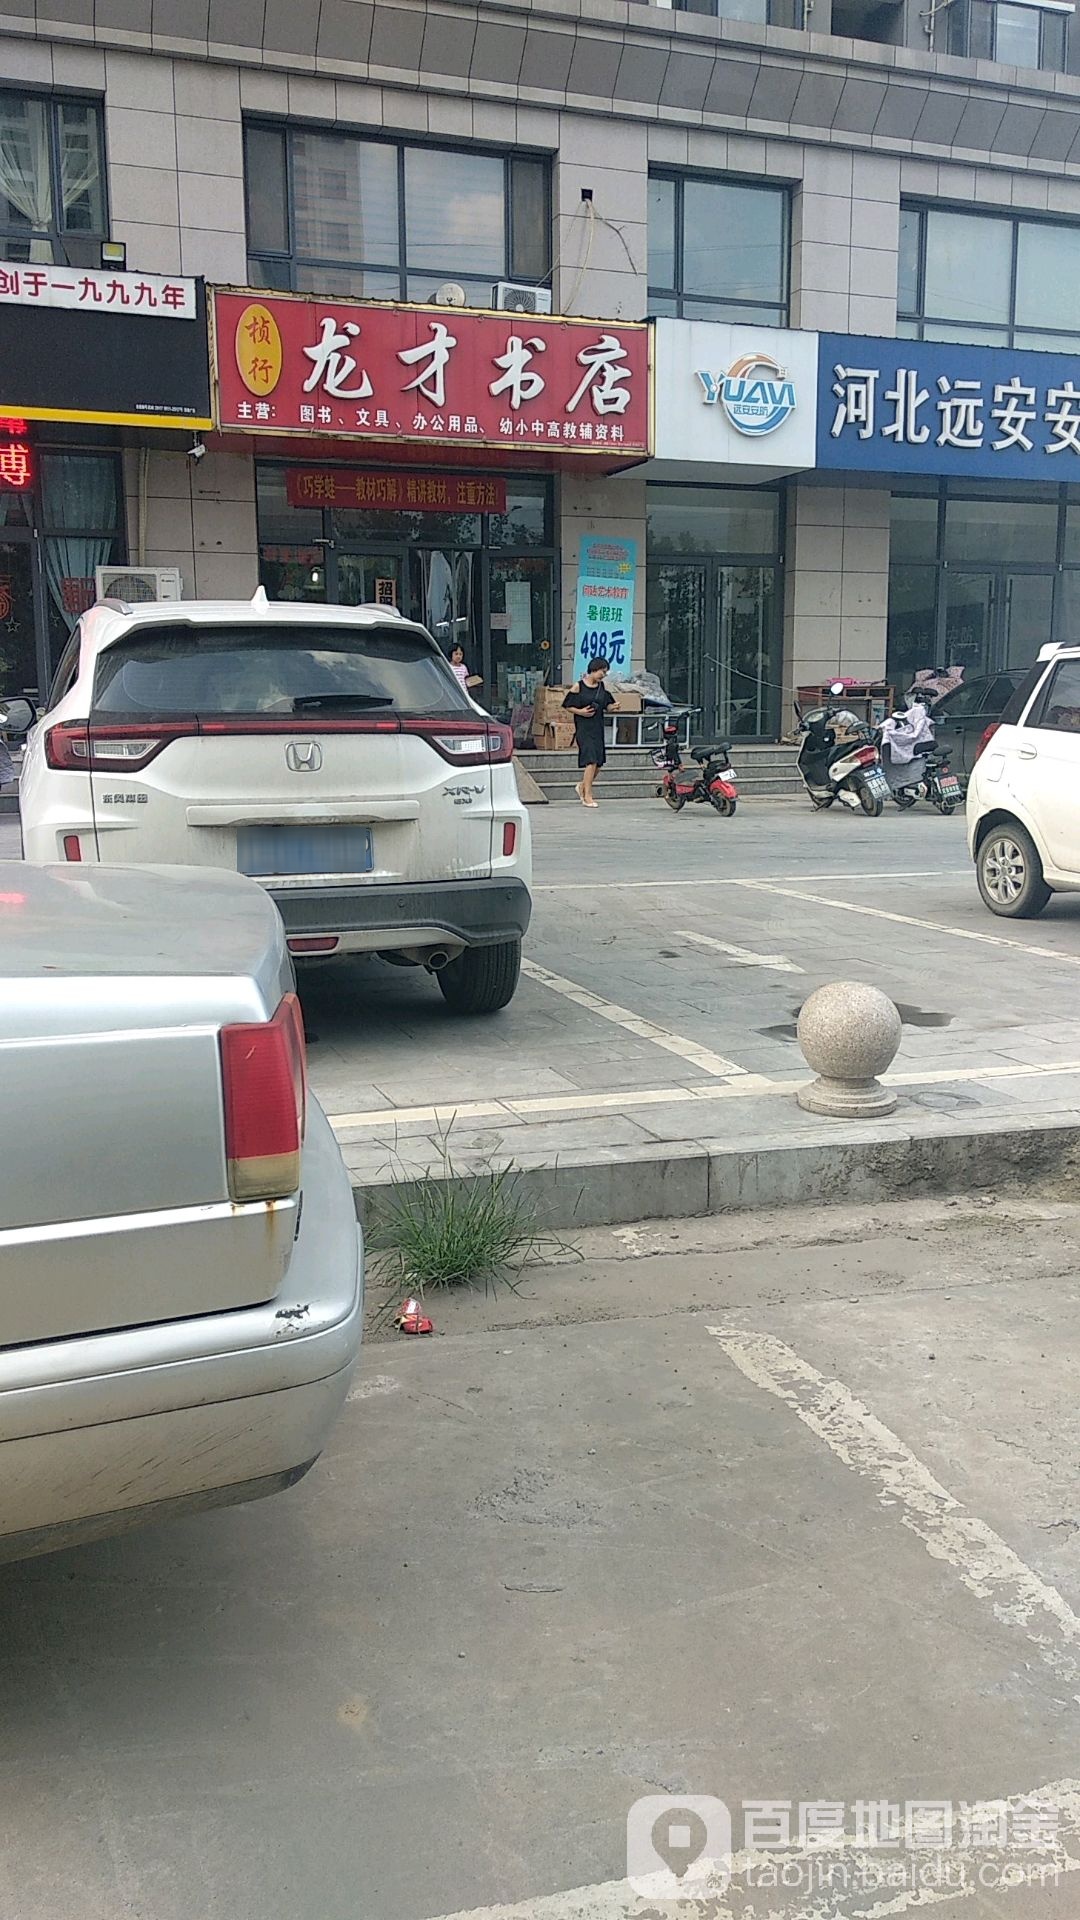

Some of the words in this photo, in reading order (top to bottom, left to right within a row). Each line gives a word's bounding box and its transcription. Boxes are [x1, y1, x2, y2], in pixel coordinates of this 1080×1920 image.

[0, 270, 185, 309] 创于一九九九年
[302, 316, 633, 416] 龙才书店
[733, 404, 769, 417] 远安安防
[830, 364, 1080, 454] 河北远安安
[586, 605, 623, 622] 暑假班
[580, 630, 625, 664] 498元
[102, 793, 148, 804] 东风本田
